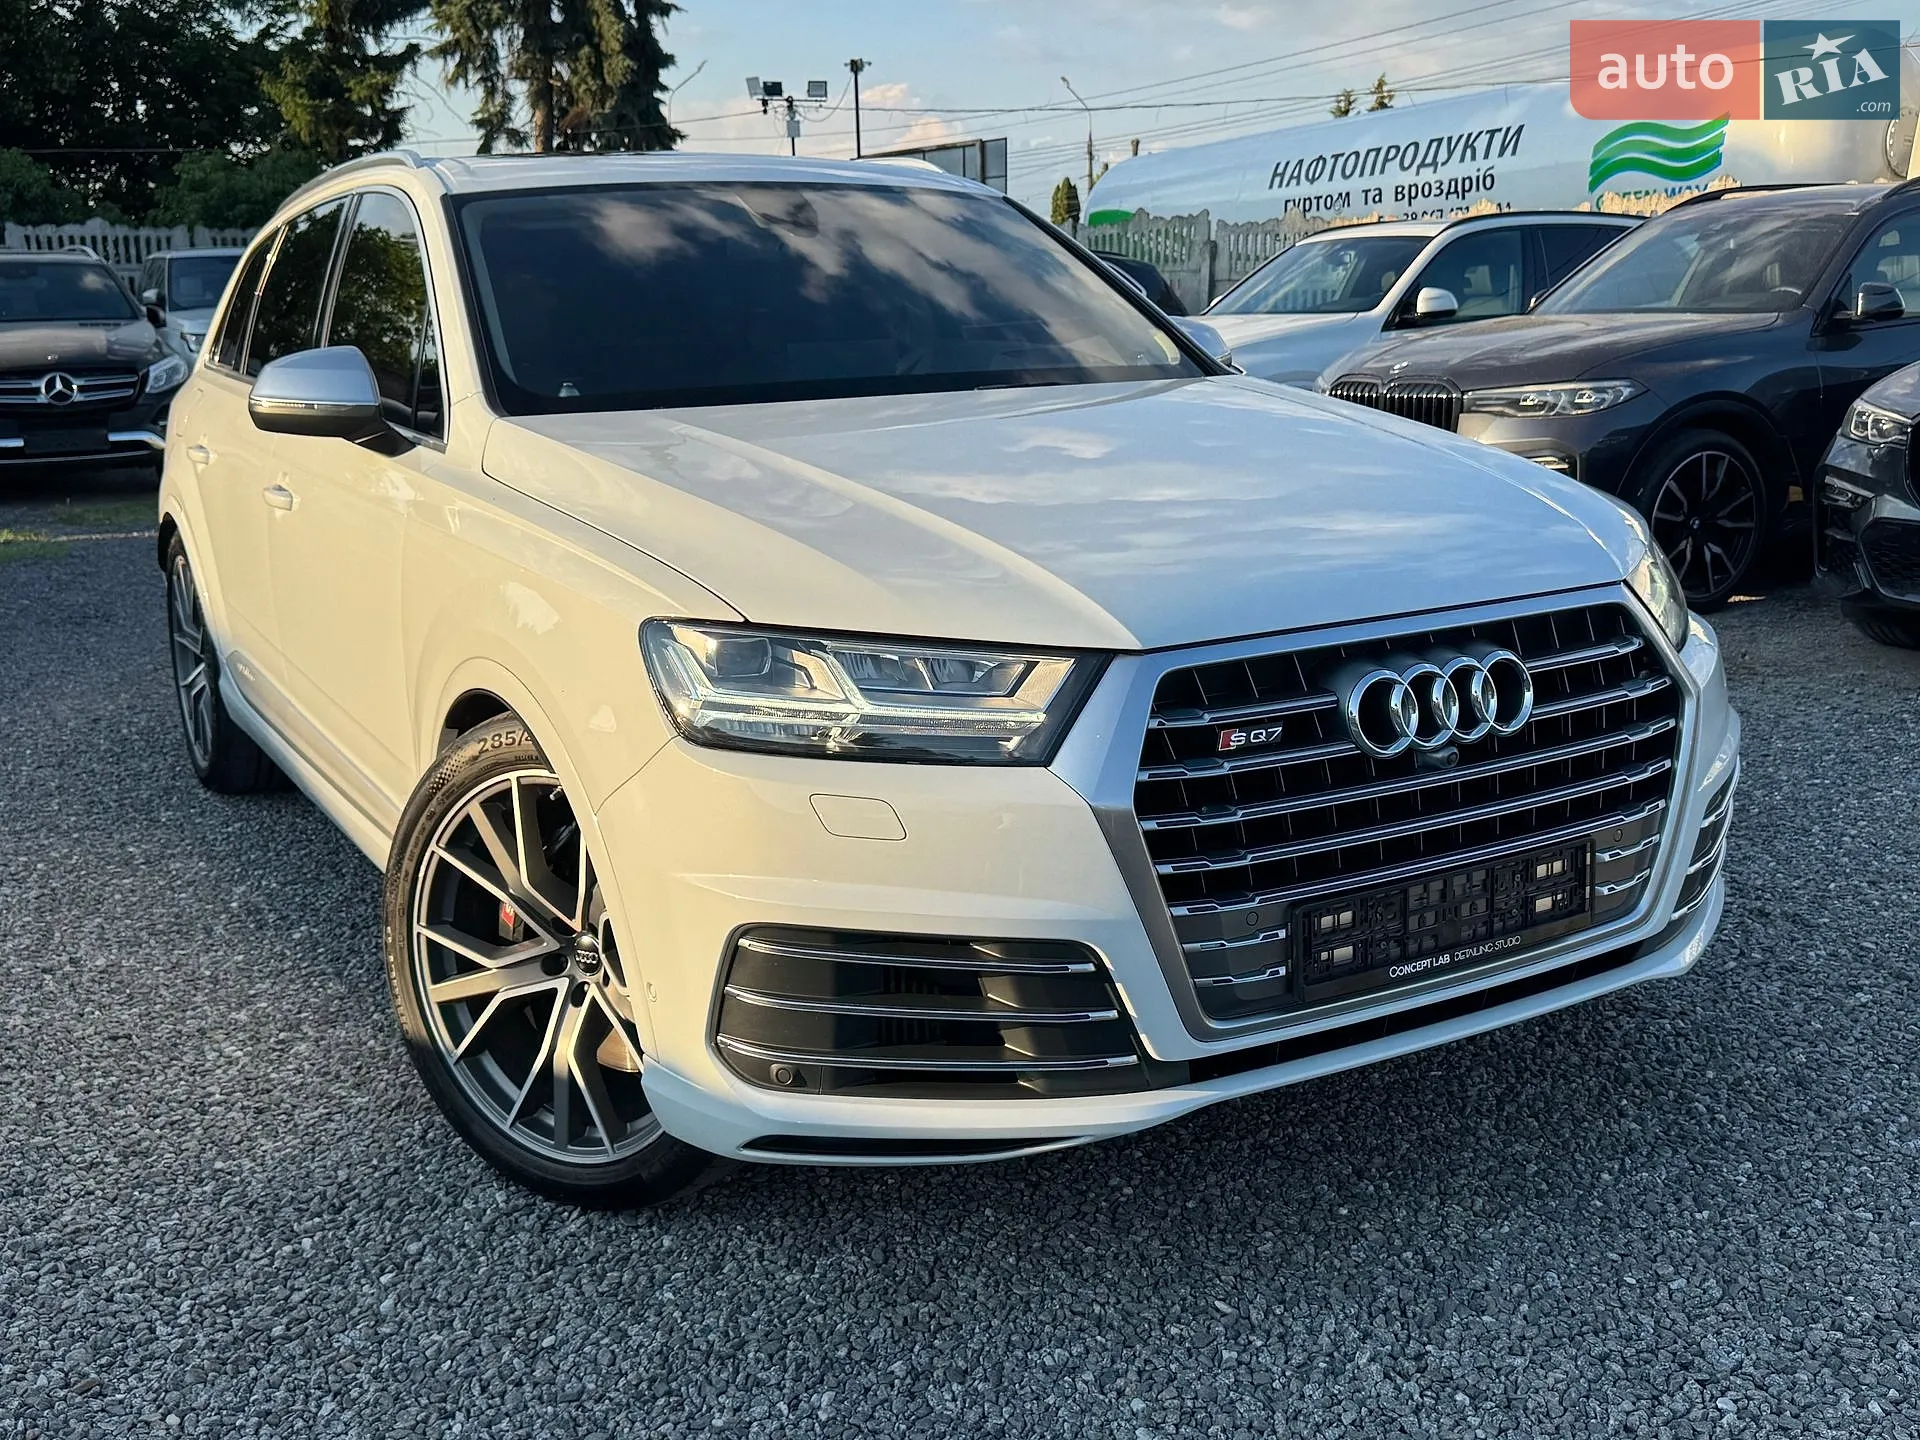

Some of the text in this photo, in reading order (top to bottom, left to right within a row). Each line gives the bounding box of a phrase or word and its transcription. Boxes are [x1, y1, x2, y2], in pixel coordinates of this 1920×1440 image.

[1267, 123, 1526, 190] НАФТОПРОДУКТИ
[1362, 187, 1383, 206] та
[1394, 165, 1496, 207] вроздріб
[1229, 726, 1283, 746] SQ7
[1389, 935, 1521, 978] CONCEPT LAB DETAILING STUDIO
